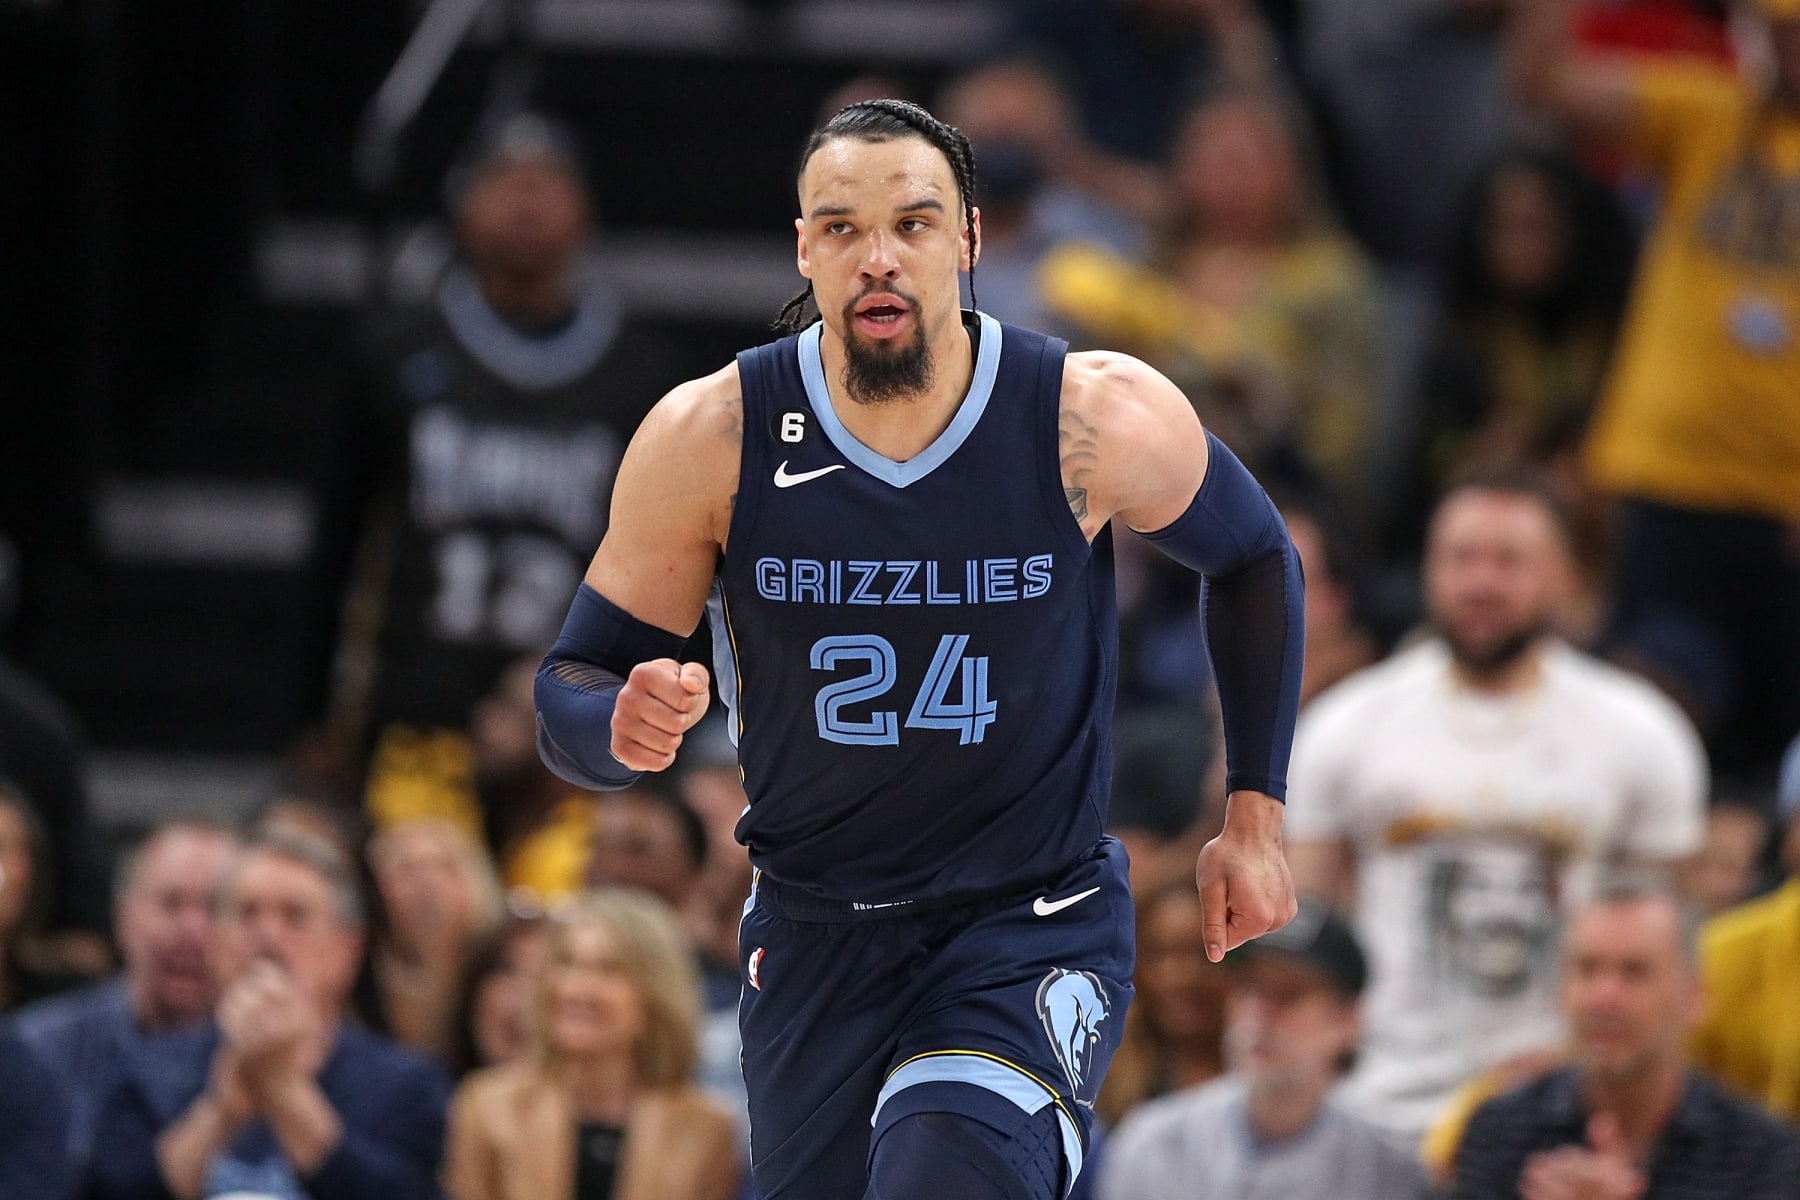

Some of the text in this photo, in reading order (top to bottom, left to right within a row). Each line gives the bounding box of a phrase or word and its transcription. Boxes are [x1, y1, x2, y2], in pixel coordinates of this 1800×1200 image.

[781, 412, 805, 443] 6
[755, 554, 1053, 605] GRIZZLIES
[810, 634, 997, 746] 24
